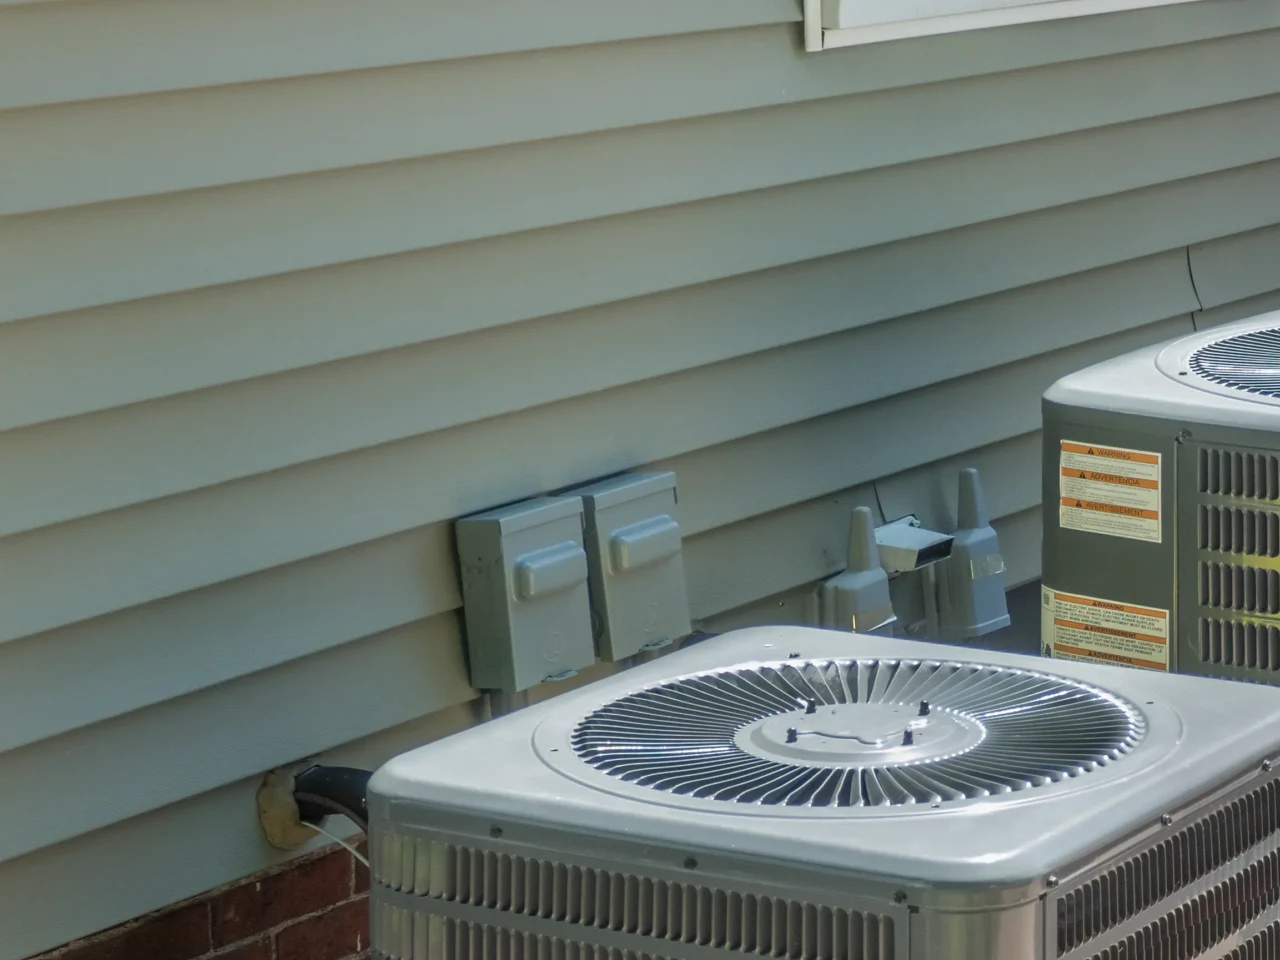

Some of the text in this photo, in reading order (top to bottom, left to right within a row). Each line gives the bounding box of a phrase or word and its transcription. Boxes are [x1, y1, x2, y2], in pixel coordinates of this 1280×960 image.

[1097, 450, 1131, 460] WARNING
[1090, 472, 1140, 486] ADVERTENCIA
[1086, 502, 1144, 517] AVERTISSEMENT
[1097, 601, 1124, 611] WARNING
[1089, 626, 1136, 638] AVERTISSEMENT
[1093, 652, 1132, 664] ADVERTENCIA
